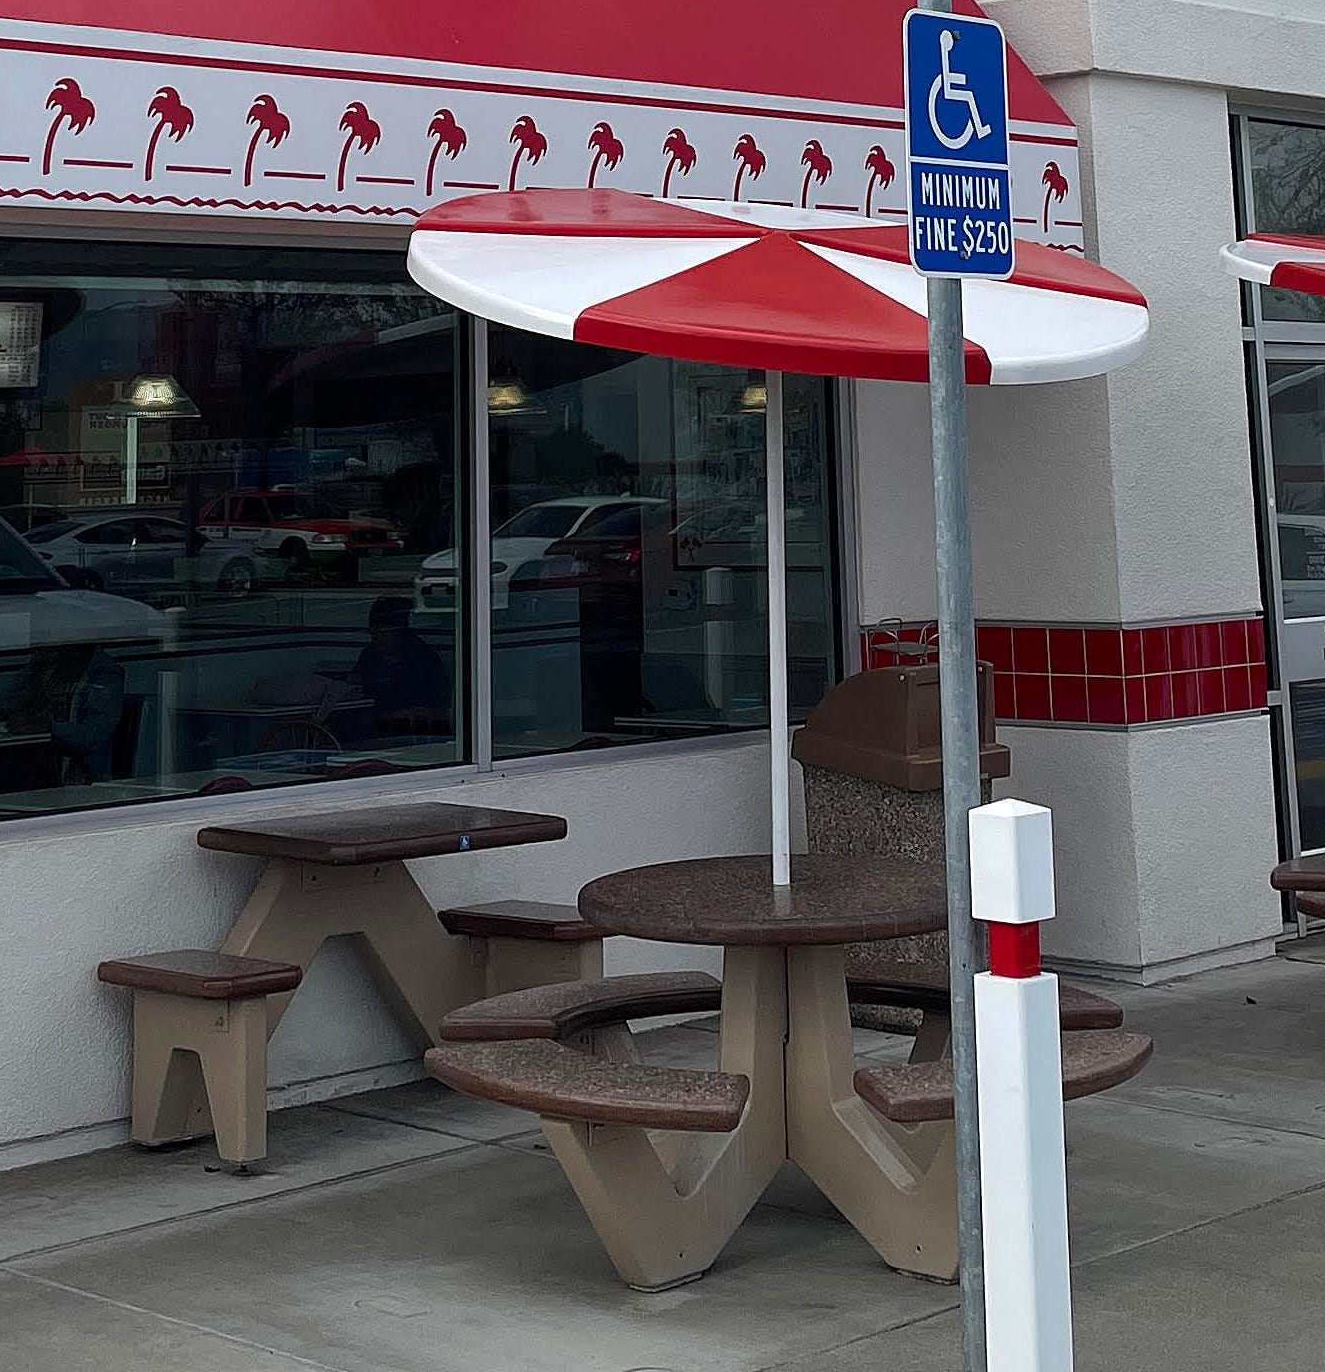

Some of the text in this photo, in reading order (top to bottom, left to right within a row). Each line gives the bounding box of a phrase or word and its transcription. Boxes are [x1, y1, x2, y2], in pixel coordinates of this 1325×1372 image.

[920, 172, 1001, 210] MINIMUM
[915, 215, 1010, 256] FINE $250
